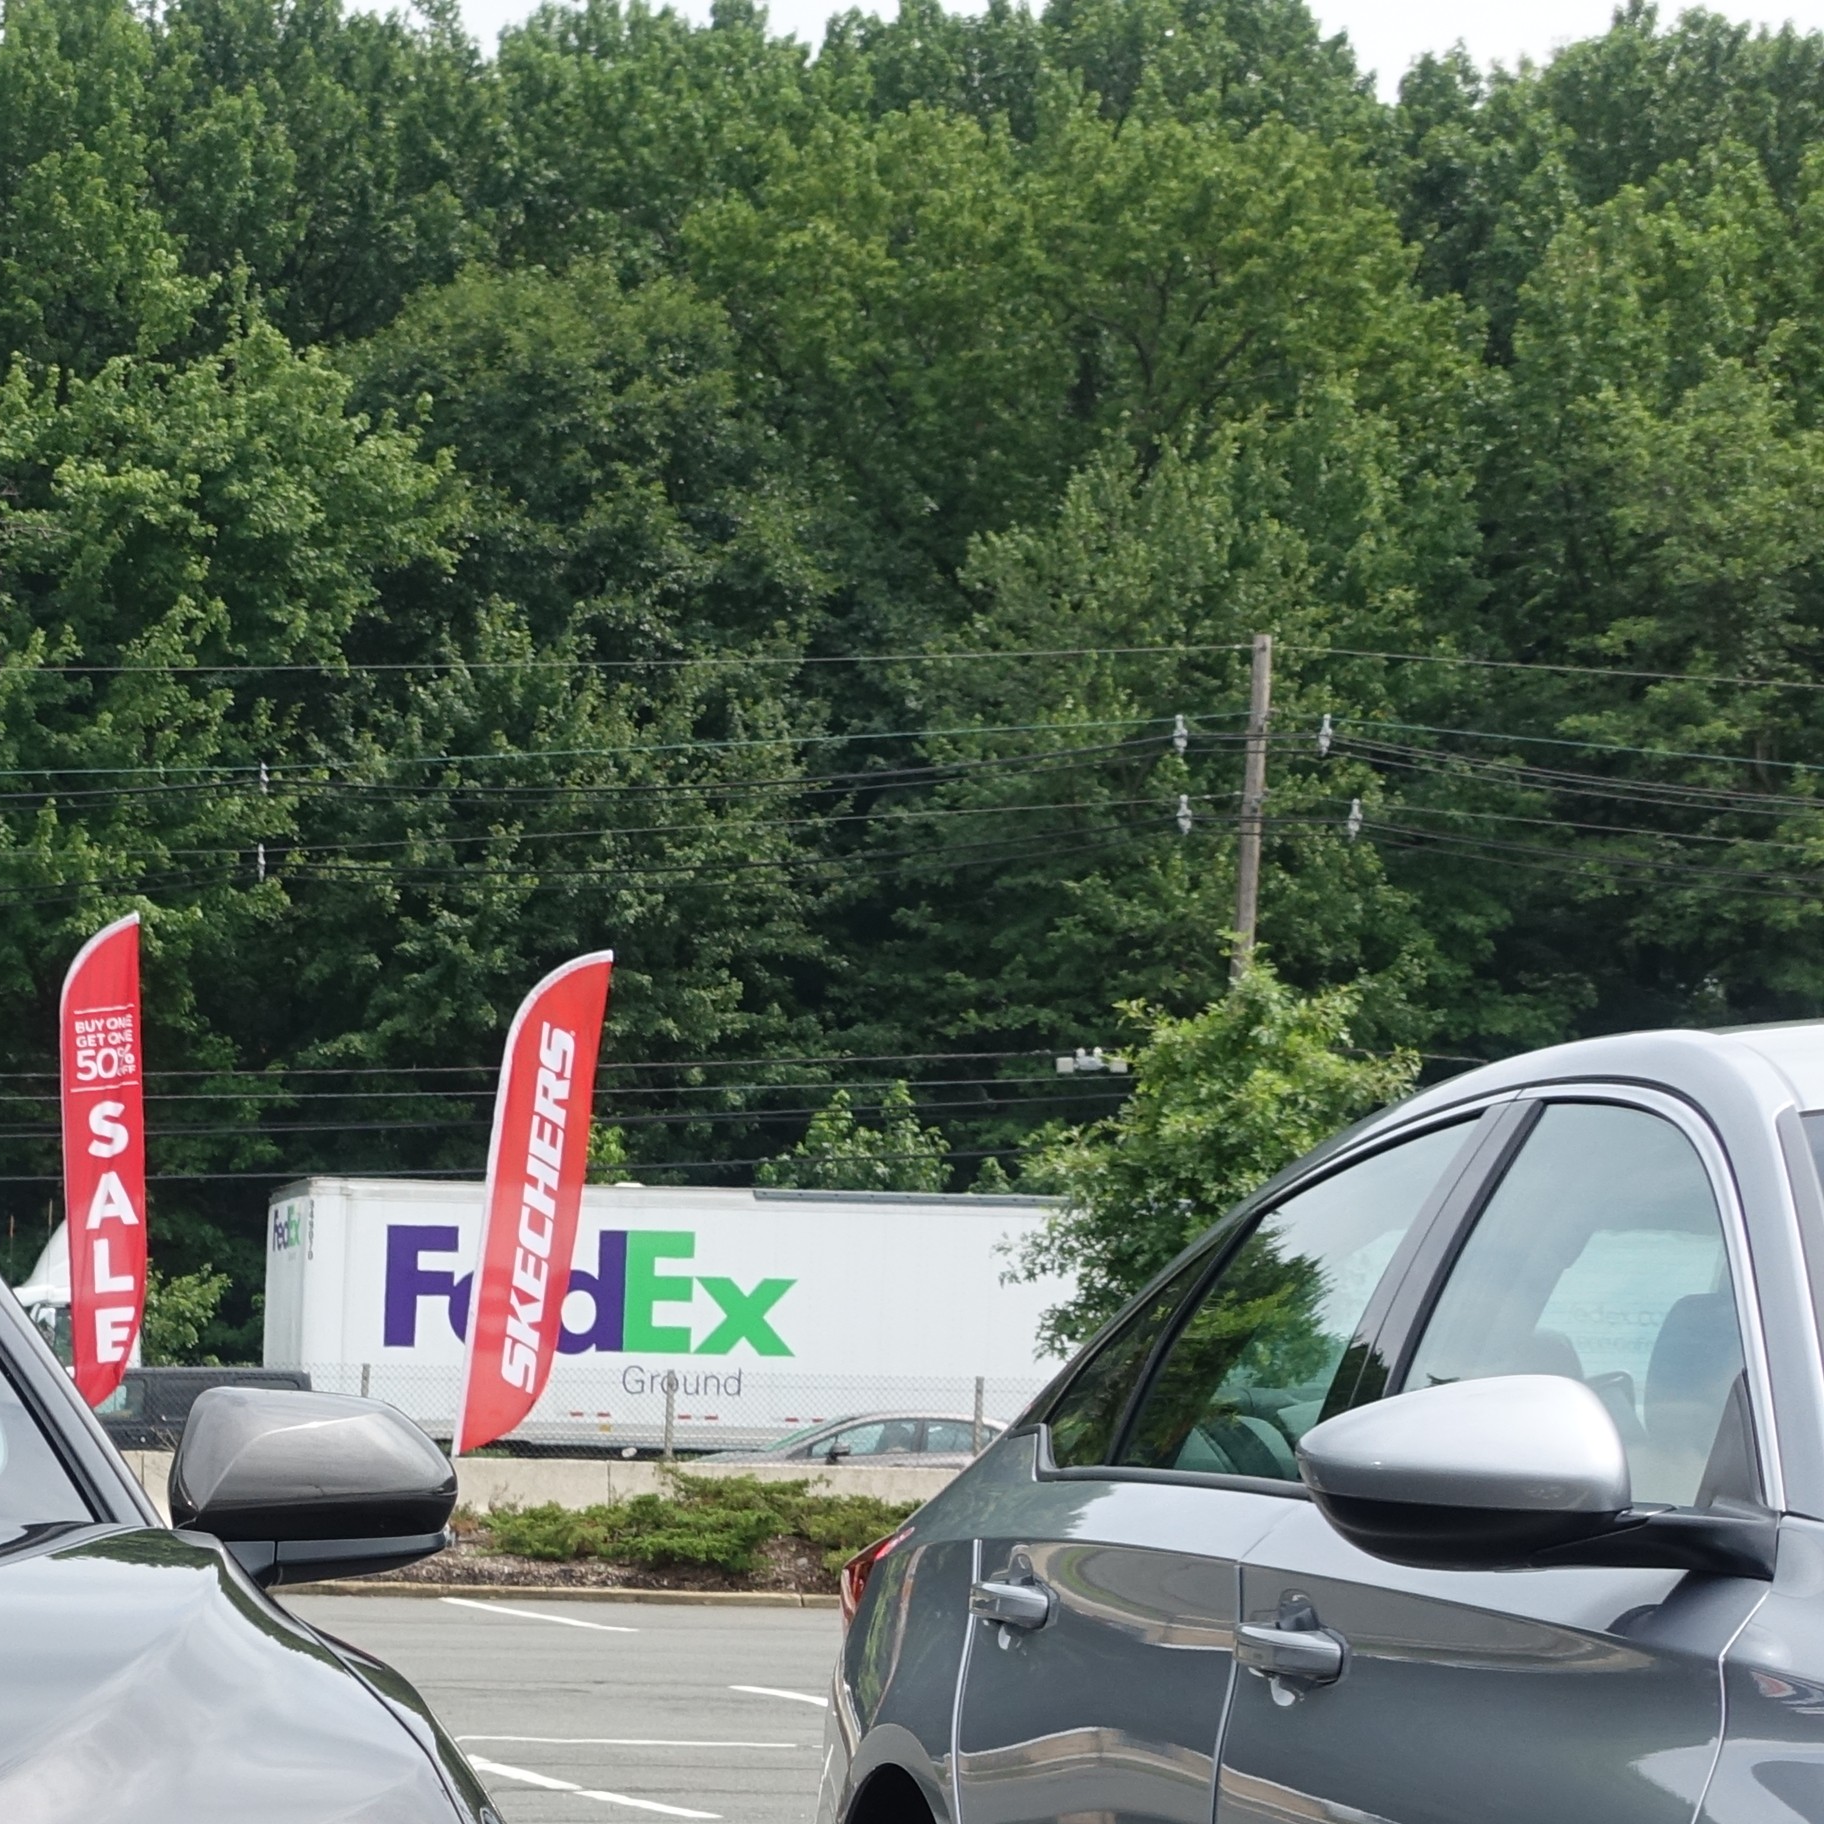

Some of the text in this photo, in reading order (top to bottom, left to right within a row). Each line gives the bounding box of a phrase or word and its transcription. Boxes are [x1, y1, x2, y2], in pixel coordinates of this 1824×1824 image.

[74, 1013, 134, 1034] BUY ONE
[75, 1028, 134, 1048] GET ONE
[76, 1043, 135, 1081] 50%
[85, 1100, 139, 1364] SALE
[501, 1021, 575, 1394] SKECHERS
[384, 1224, 798, 1357] FdEx
